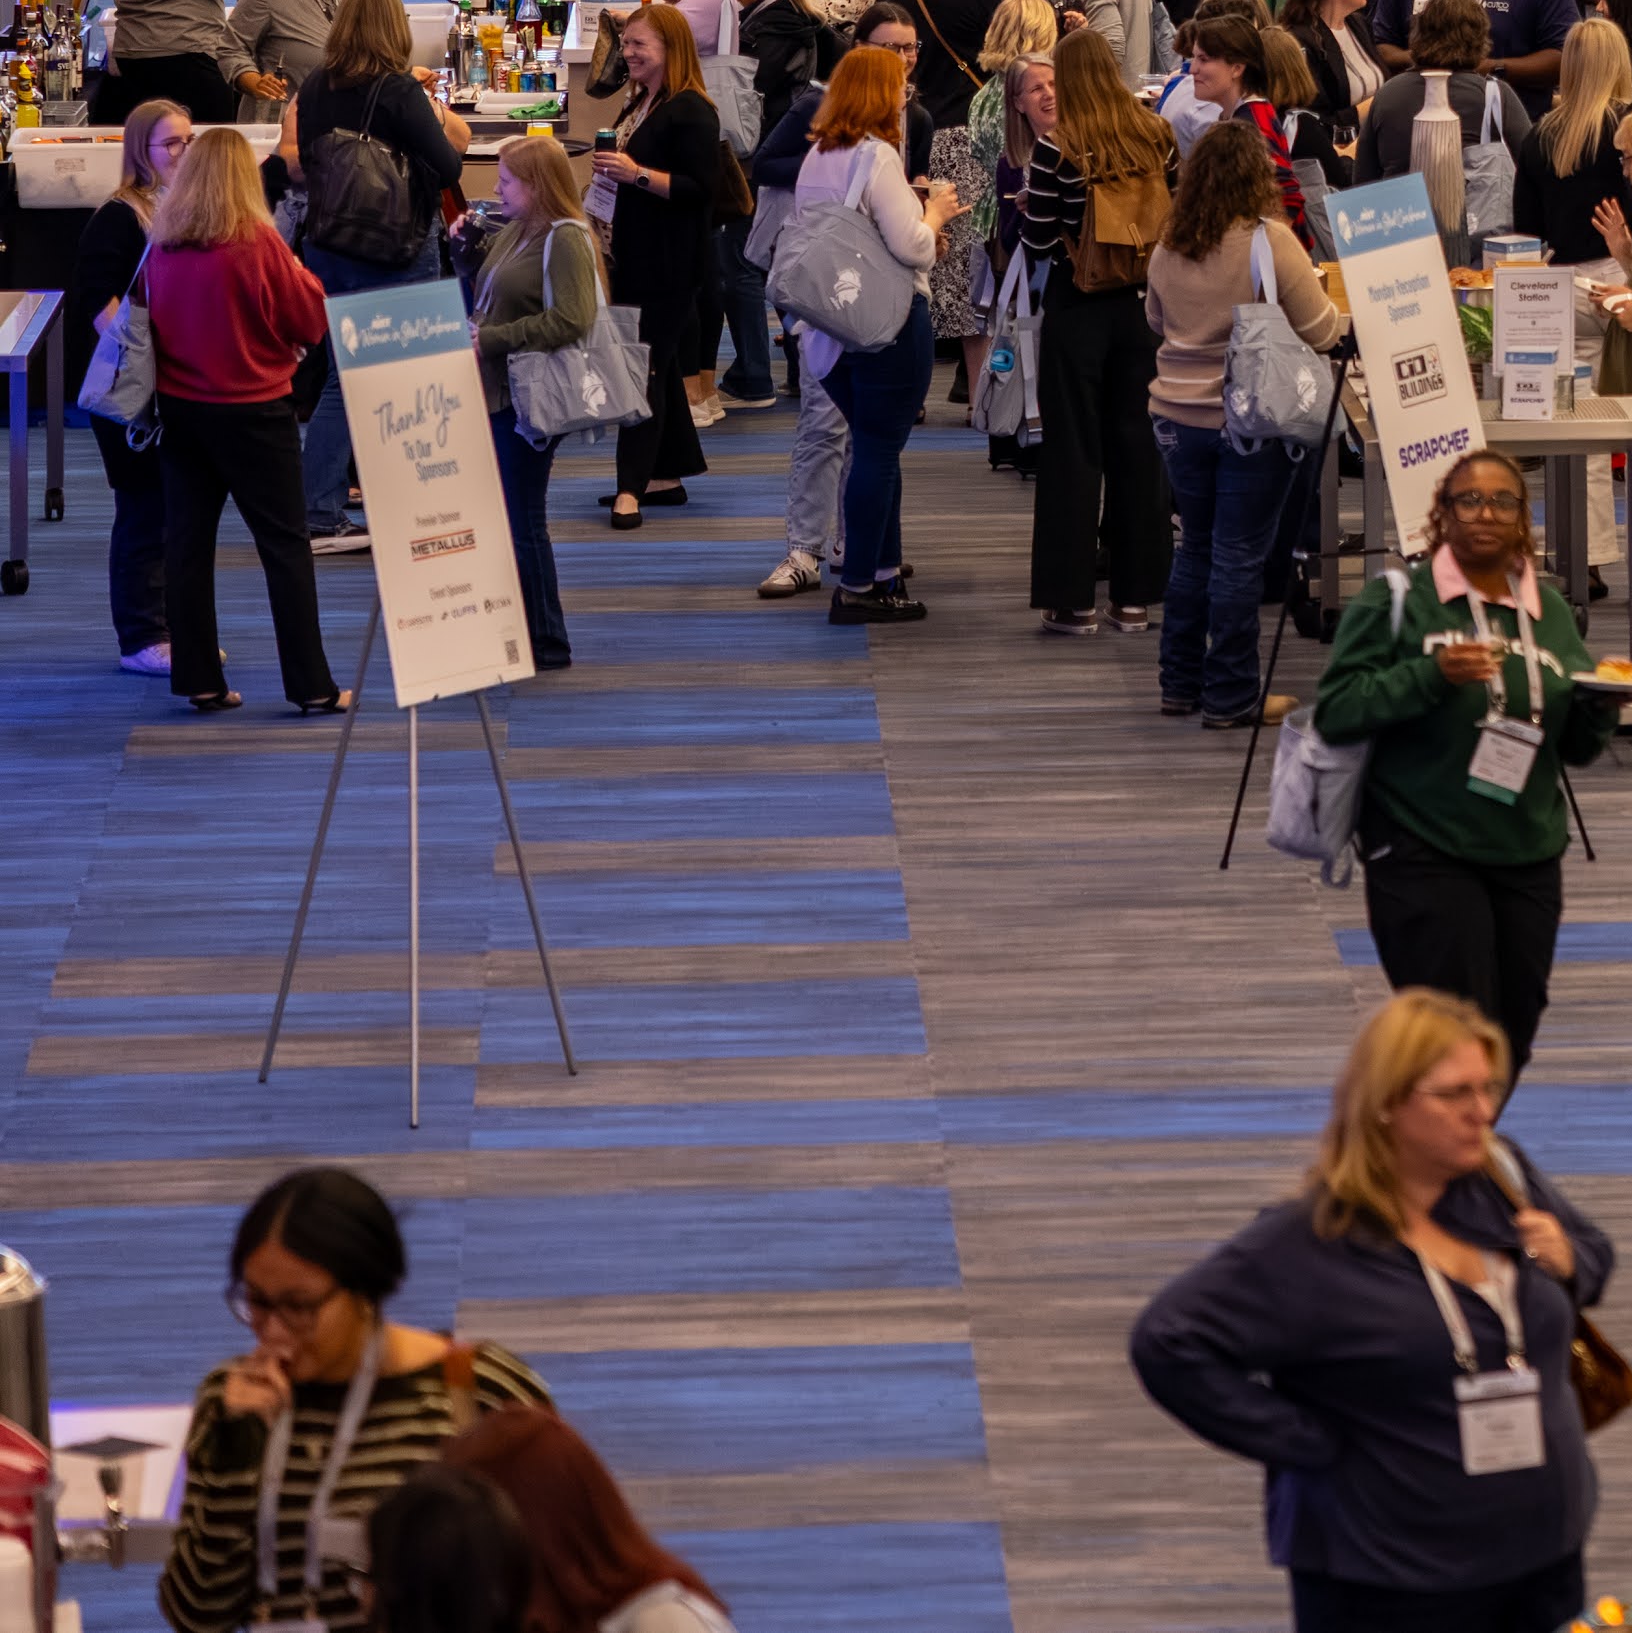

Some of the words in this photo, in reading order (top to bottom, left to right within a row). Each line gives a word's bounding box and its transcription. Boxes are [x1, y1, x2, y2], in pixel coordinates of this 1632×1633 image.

[1367, 282, 1396, 304] Monday
[1395, 273, 1431, 297] Reception
[1510, 281, 1558, 291] Cleveland
[1518, 293, 1550, 302] Station
[1387, 302, 1422, 325] Sponsors
[418, 315, 461, 341] Conference
[1399, 373, 1444, 401] BUILDINGS
[372, 388, 428, 446] Thank
[424, 382, 461, 449] You
[402, 441, 414, 461] To
[415, 440, 432, 458] Our
[1399, 428, 1470, 469] SCRAPCHEF
[414, 460, 460, 484] Sponsors
[437, 511, 461, 525] Sponsor
[411, 532, 476, 558] METALLUS
[444, 582, 474, 599] Sponsors
